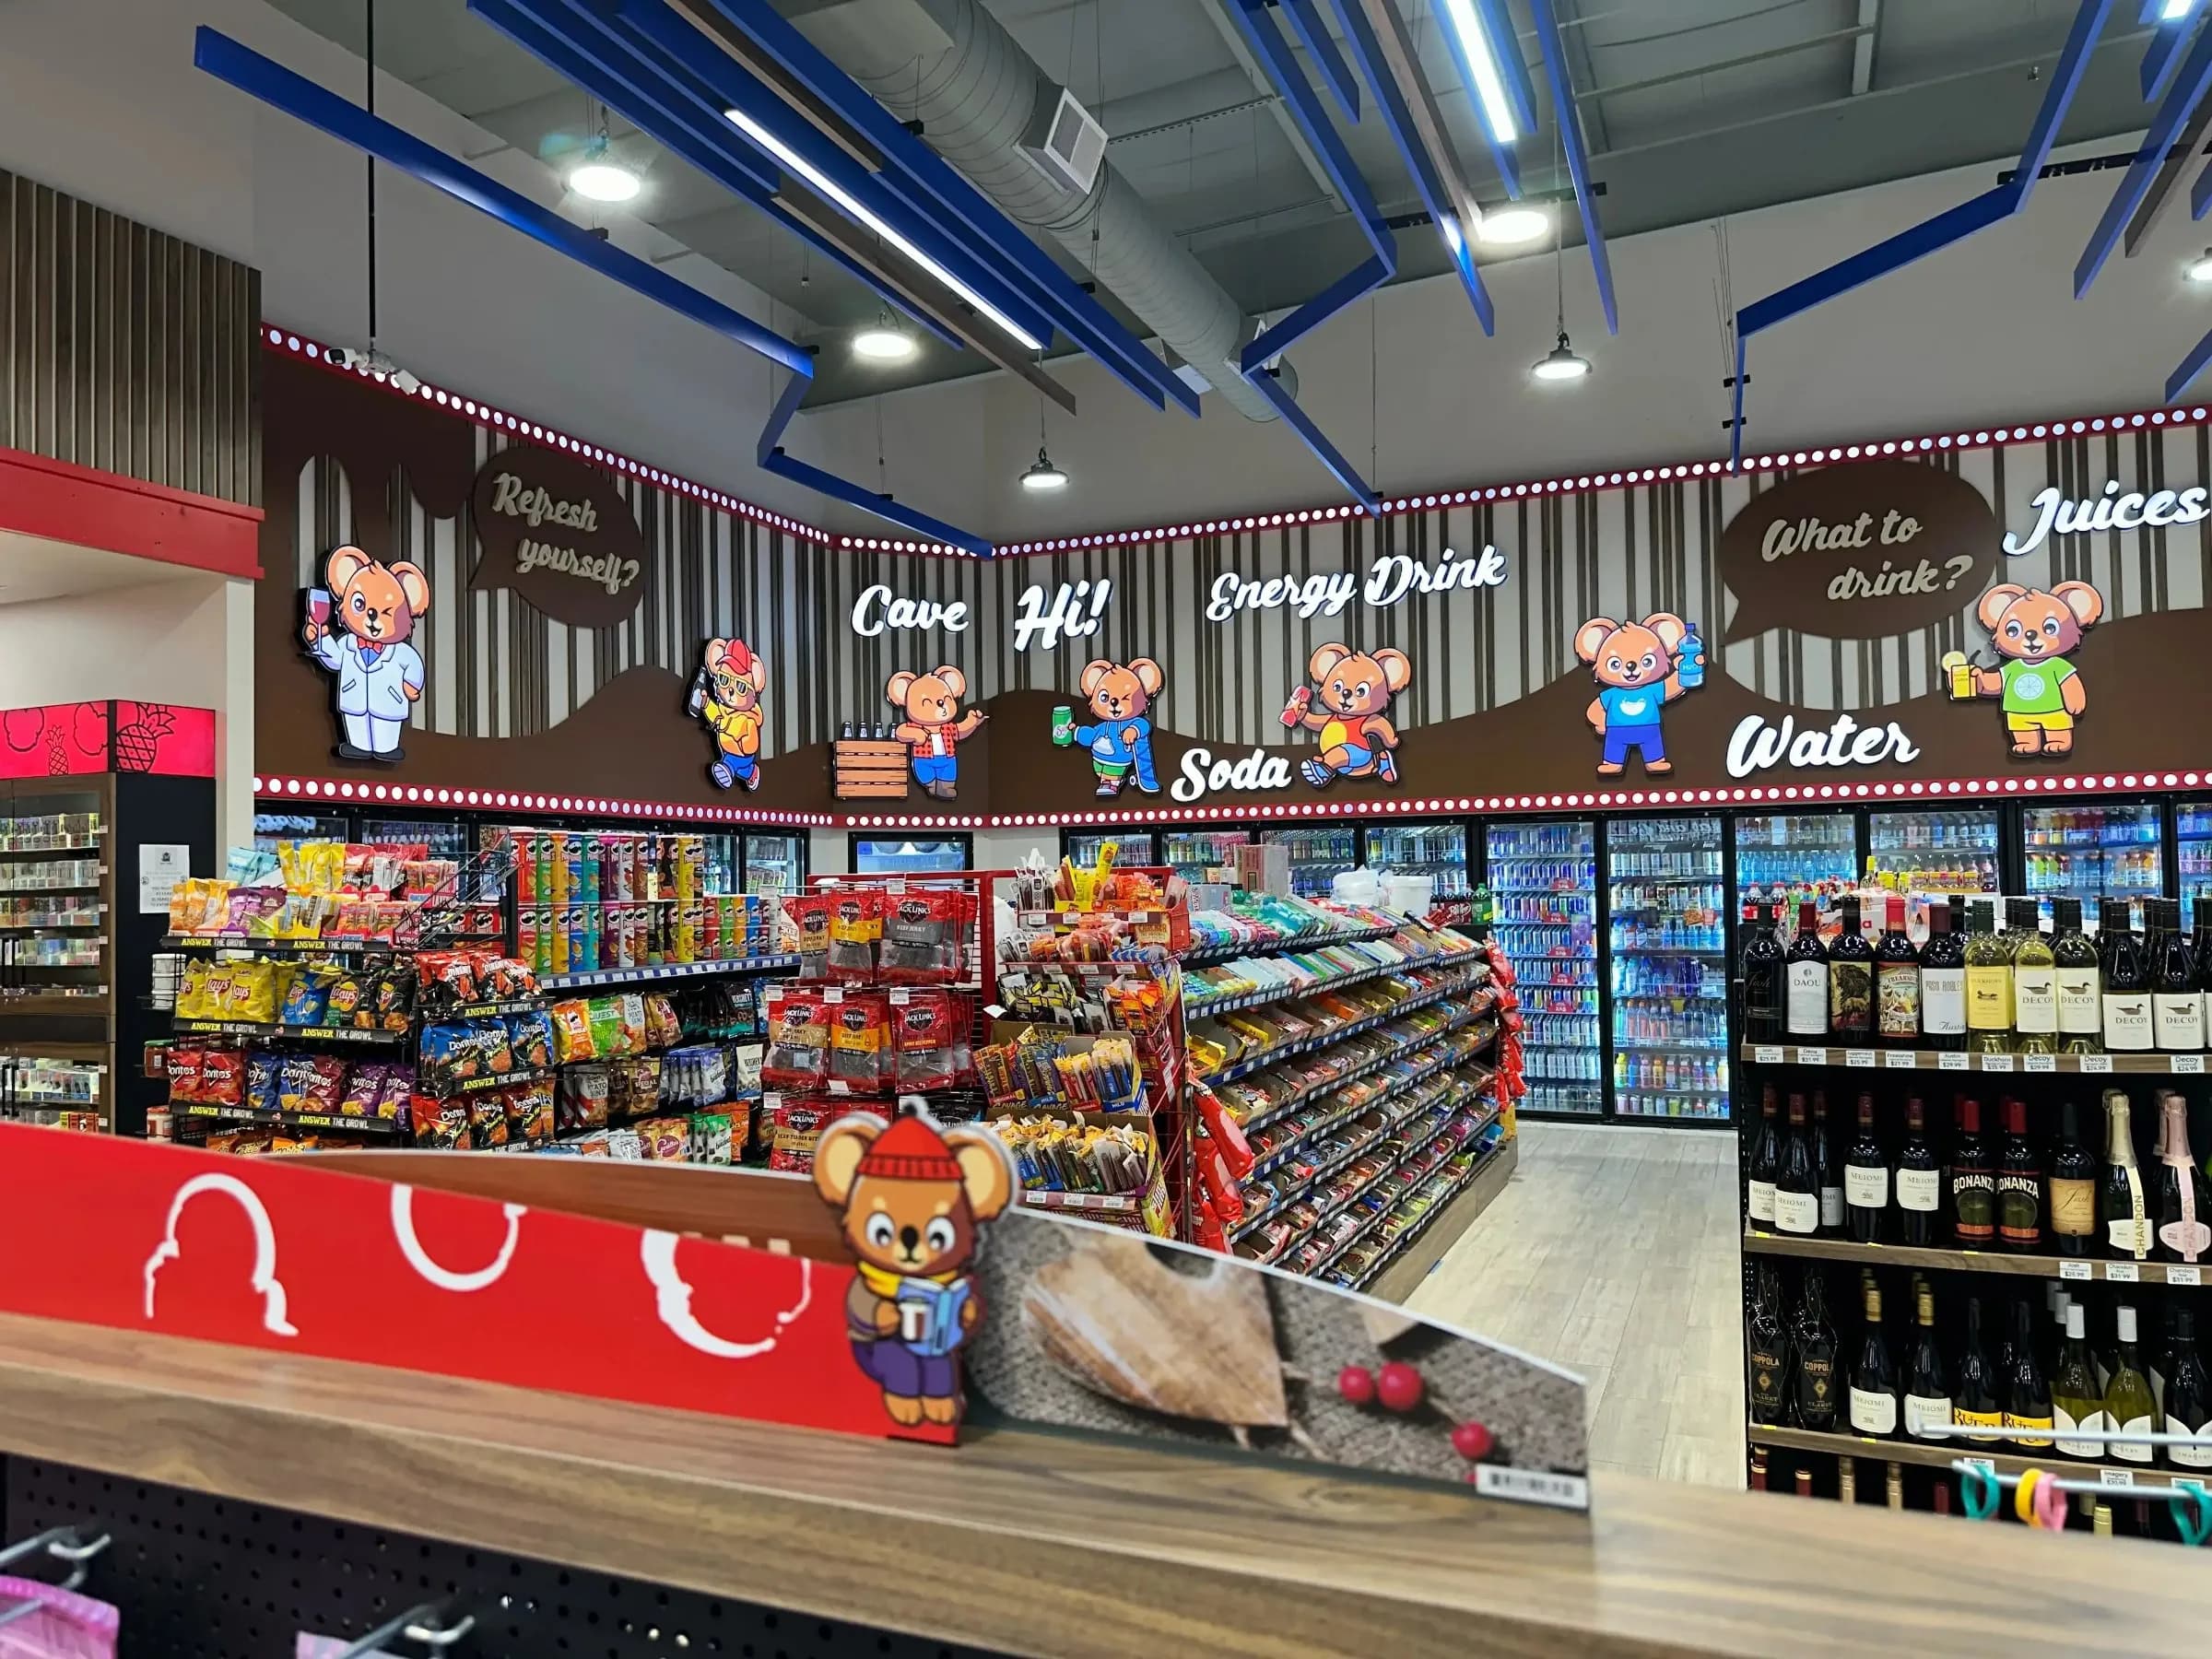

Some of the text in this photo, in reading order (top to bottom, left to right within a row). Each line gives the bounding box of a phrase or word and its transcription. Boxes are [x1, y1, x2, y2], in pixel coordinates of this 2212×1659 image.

[492, 472, 597, 532] Refresh
[2002, 479, 2210, 557] Juices
[1761, 509, 1923, 562] What to
[516, 537, 641, 595] yourself?
[1206, 545, 1509, 623] Energy Drink
[1827, 554, 1974, 601] drink?
[851, 584, 970, 638] Cave
[1013, 579, 1112, 652] Hi!
[1725, 714, 1921, 778] Water
[1170, 747, 1291, 804] Soda
[897, 904, 912, 912] JACK
[182, 938, 247, 947] ANSWER THE GROWL
[293, 940, 364, 950] ANSWER THE GROWL
[1794, 979, 1821, 987] DAOU
[2061, 995, 2094, 1005] DECOY
[465, 1003, 532, 1017] ANSWER THE GROWL
[905, 1015, 919, 1023] JACK
[191, 1022, 257, 1033] ANSWER THE GROWL
[301, 1029, 372, 1040] ANSWER THE GROWL
[2084, 1055, 2107, 1064] Decoy
[203, 1068, 231, 1079] Doritos
[463, 1072, 532, 1089] ANSWER THE GROWL
[189, 1106, 254, 1119] ANSWER THE GROWL
[786, 1113, 804, 1123] JACK
[299, 1115, 370, 1128] ANSWER THE GROWL
[508, 1142, 529, 1152] GROWL
[1851, 1171, 1884, 1181] MEIOMI
[2134, 1194, 2147, 1256] CHANDON
[1912, 1403, 1947, 1412] MEIOMI
